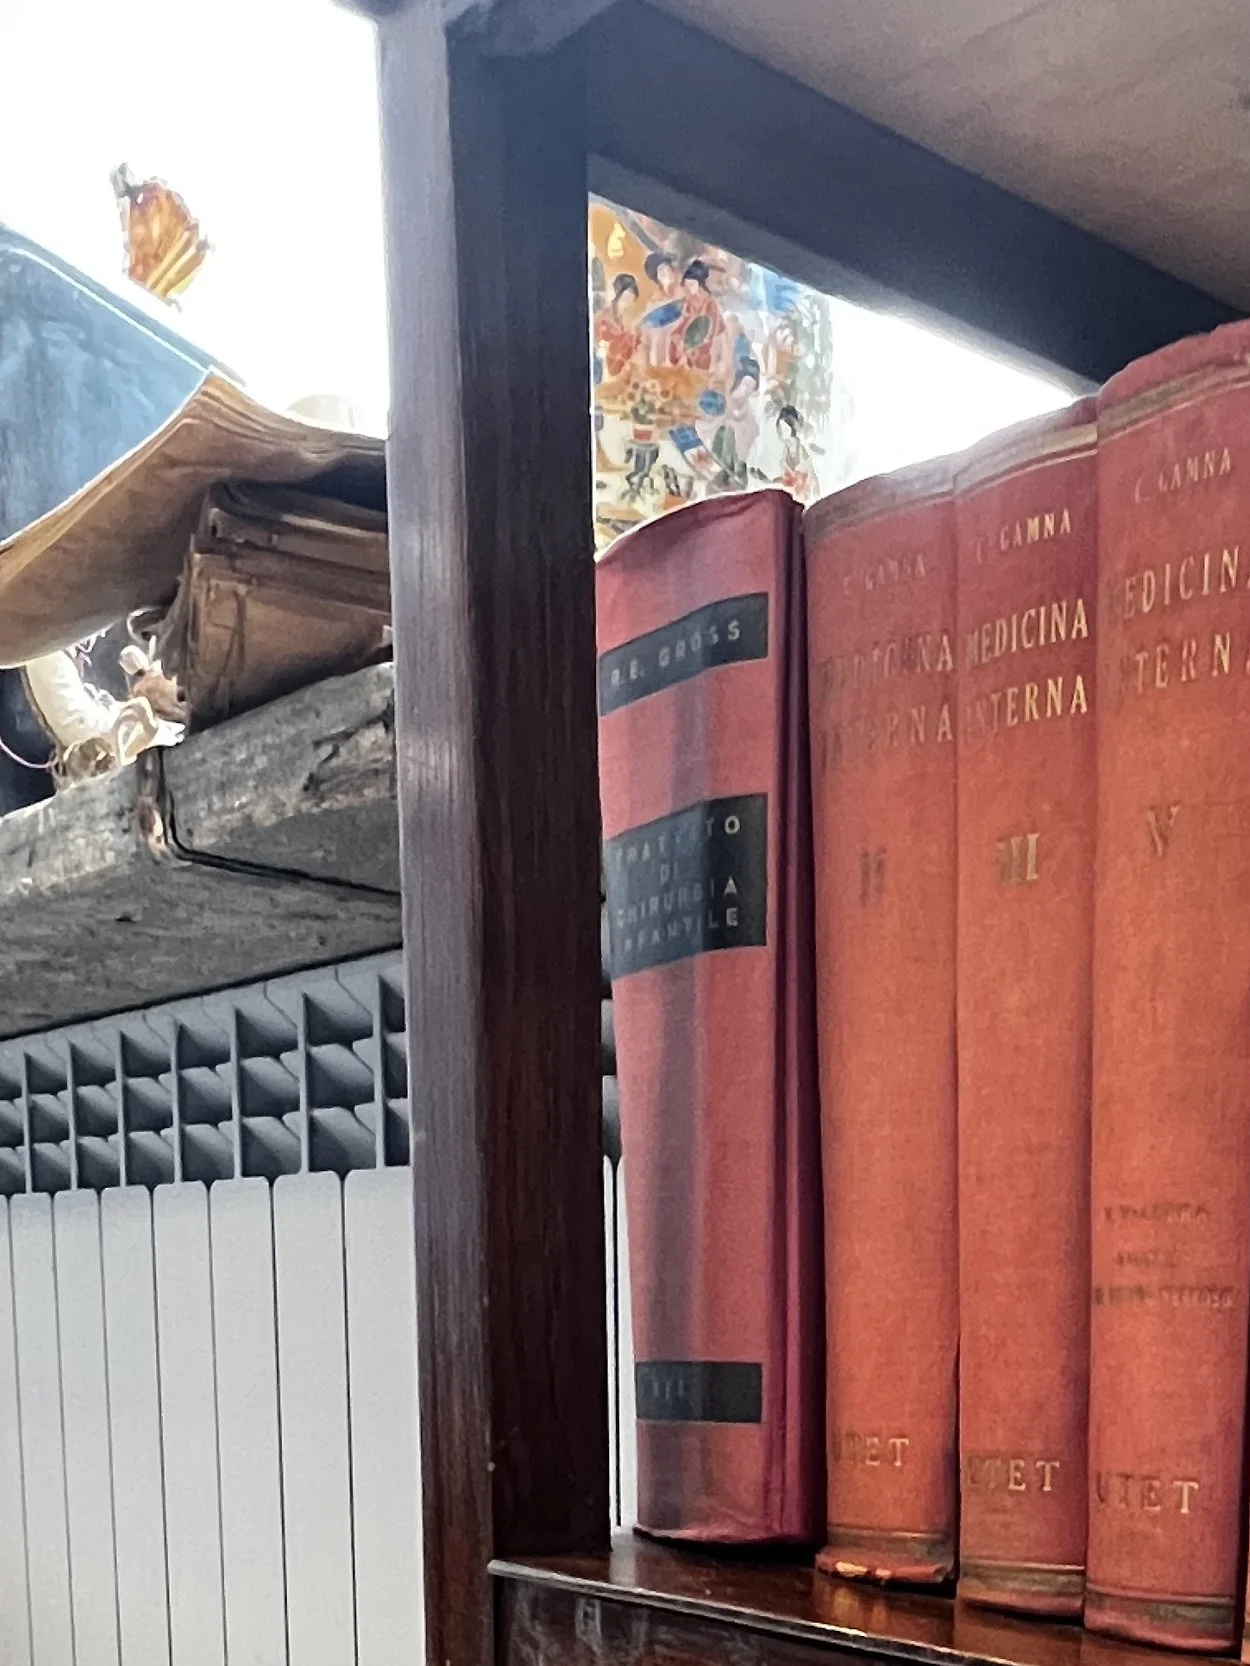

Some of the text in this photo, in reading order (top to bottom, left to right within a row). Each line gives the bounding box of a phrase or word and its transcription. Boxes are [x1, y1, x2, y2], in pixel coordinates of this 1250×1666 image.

[659, 619, 740, 668] GROSS
[965, 597, 1088, 670] MEDICINA
[613, 907, 739, 953] NFANTILE
[1096, 1470, 1199, 1514] UTET
